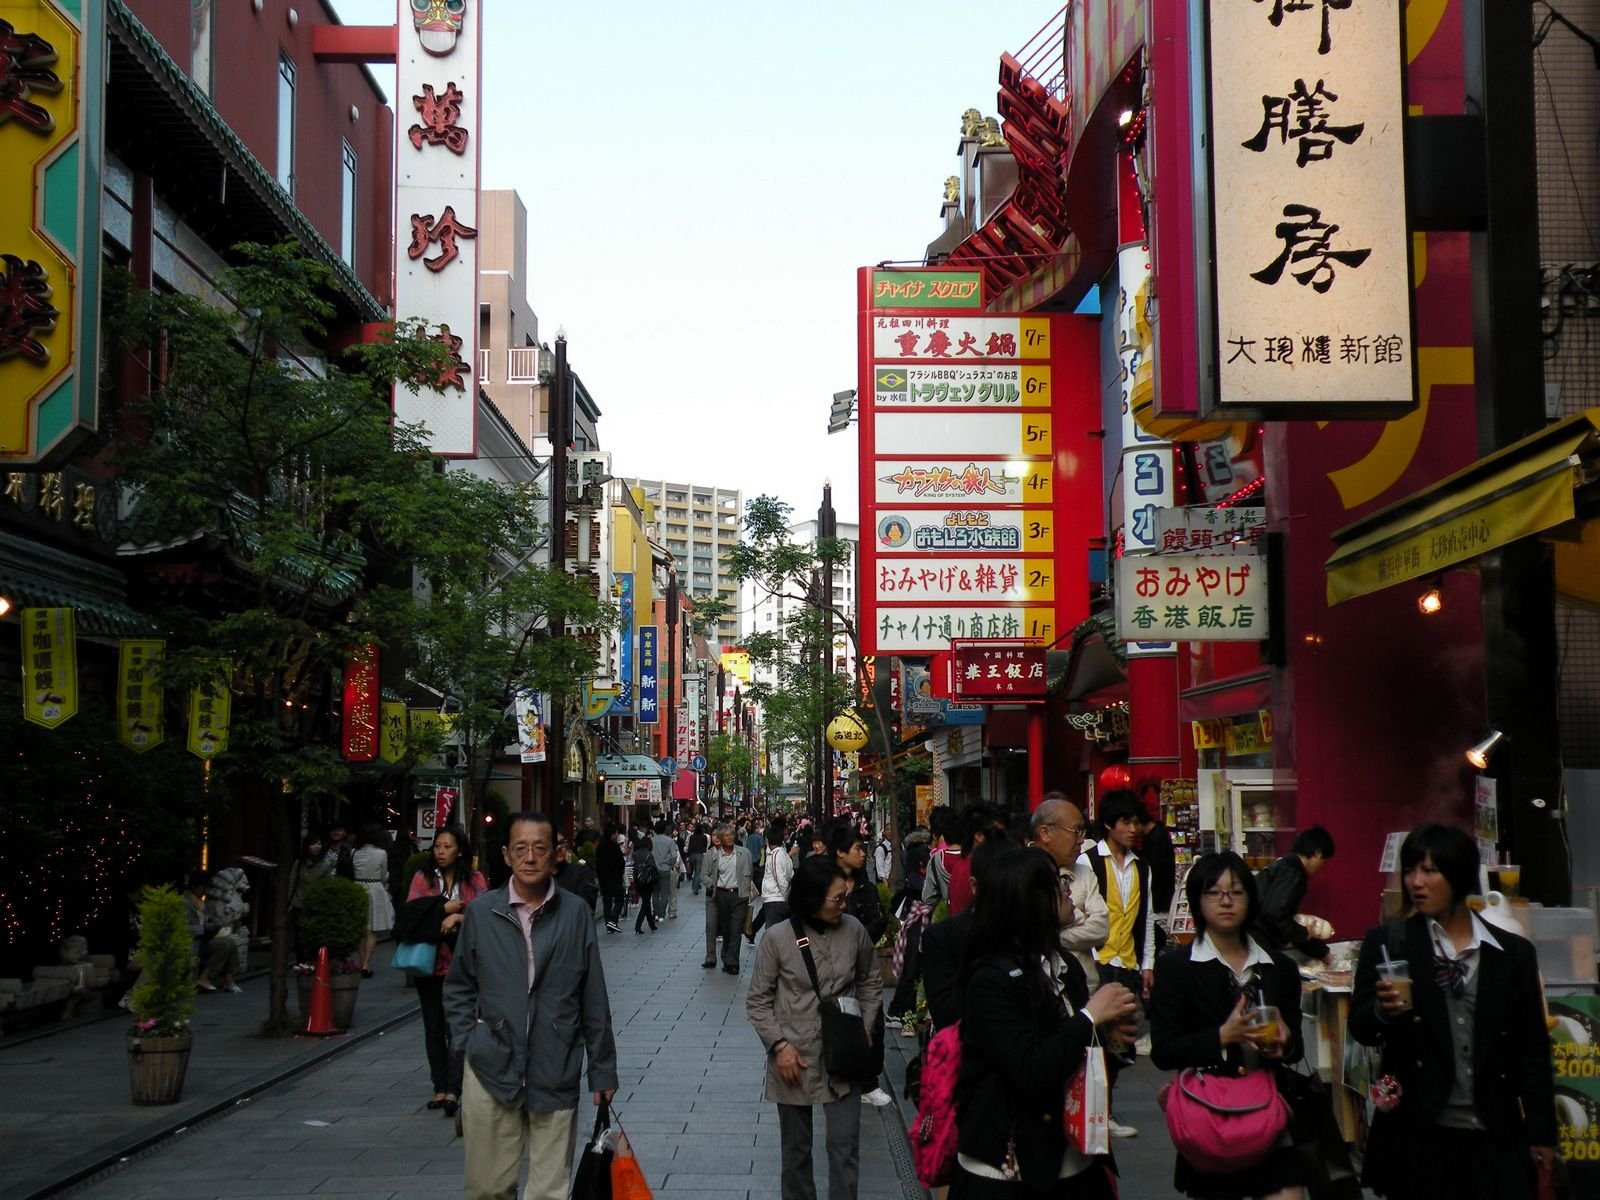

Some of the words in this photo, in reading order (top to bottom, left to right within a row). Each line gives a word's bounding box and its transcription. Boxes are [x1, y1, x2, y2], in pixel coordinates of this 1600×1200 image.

[876, 280, 925, 298] チャイナ
[928, 280, 979, 298] スクエア
[877, 318, 950, 329] 元祖四川料理
[894, 330, 1017, 358] 重慶火鍋
[1025, 329, 1046, 346] 7F
[1026, 378, 1047, 394] 6F
[876, 394, 888, 402] by
[1026, 425, 1048, 442] 5F
[892, 462, 1007, 496] カラオケの鉄人
[1027, 473, 1049, 490] 4F
[945, 512, 989, 527] よしもと
[915, 527, 1020, 549] おもしろ水族館
[1028, 522, 1050, 539] 3F
[879, 564, 1020, 595] おみやげ&雑貨
[1028, 571, 1051, 588] 2F
[1135, 564, 1251, 598] おみやげ
[1131, 604, 1255, 629] 香港飯店
[879, 612, 1020, 642] チャイナ通り商店街
[1030, 619, 1051, 639] 1F
[984, 651, 1025, 659] 中国料理
[965, 662, 1044, 680] 華王飯店
[641, 675, 656, 711] 新新
[678, 725, 687, 757] カモメ
